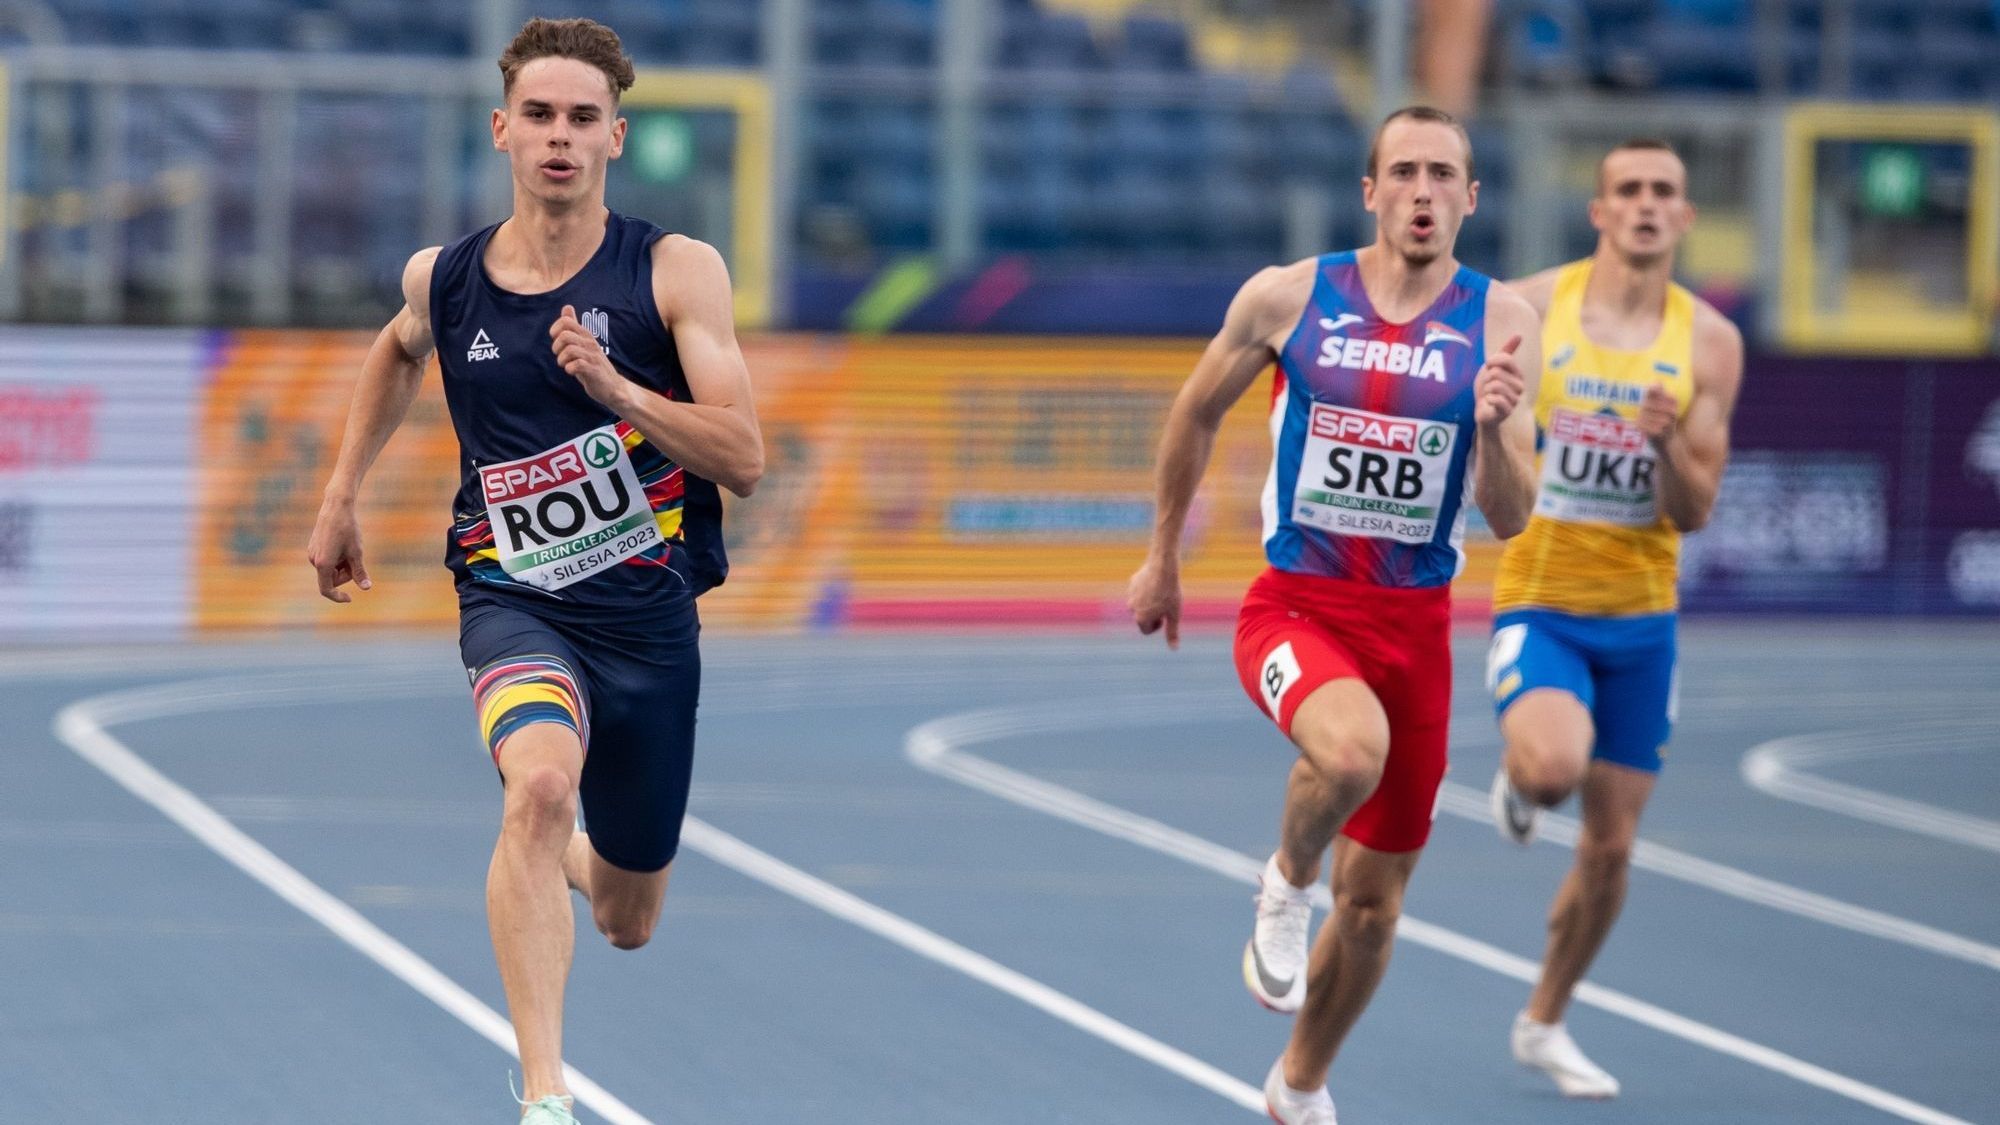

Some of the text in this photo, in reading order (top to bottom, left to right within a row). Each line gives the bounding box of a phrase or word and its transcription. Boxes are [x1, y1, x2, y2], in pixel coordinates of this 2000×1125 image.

[467, 347, 500, 362] PEAK
[1316, 336, 1446, 383] SERBIA
[1567, 376, 1643, 404] UKRAIN
[1313, 411, 1416, 450] SPAR
[485, 450, 582, 499] SPAR
[1323, 447, 1423, 500] SRB
[1560, 445, 1656, 490] UKR
[500, 469, 631, 552] ROU
[1331, 494, 1362, 508] RUN
[1338, 514, 1431, 537] SILESIA 2023
[533, 554, 538, 565] I
[540, 544, 570, 561] RUN
[554, 527, 656, 581] SILESIA 2023
[1266, 661, 1284, 698] 8
